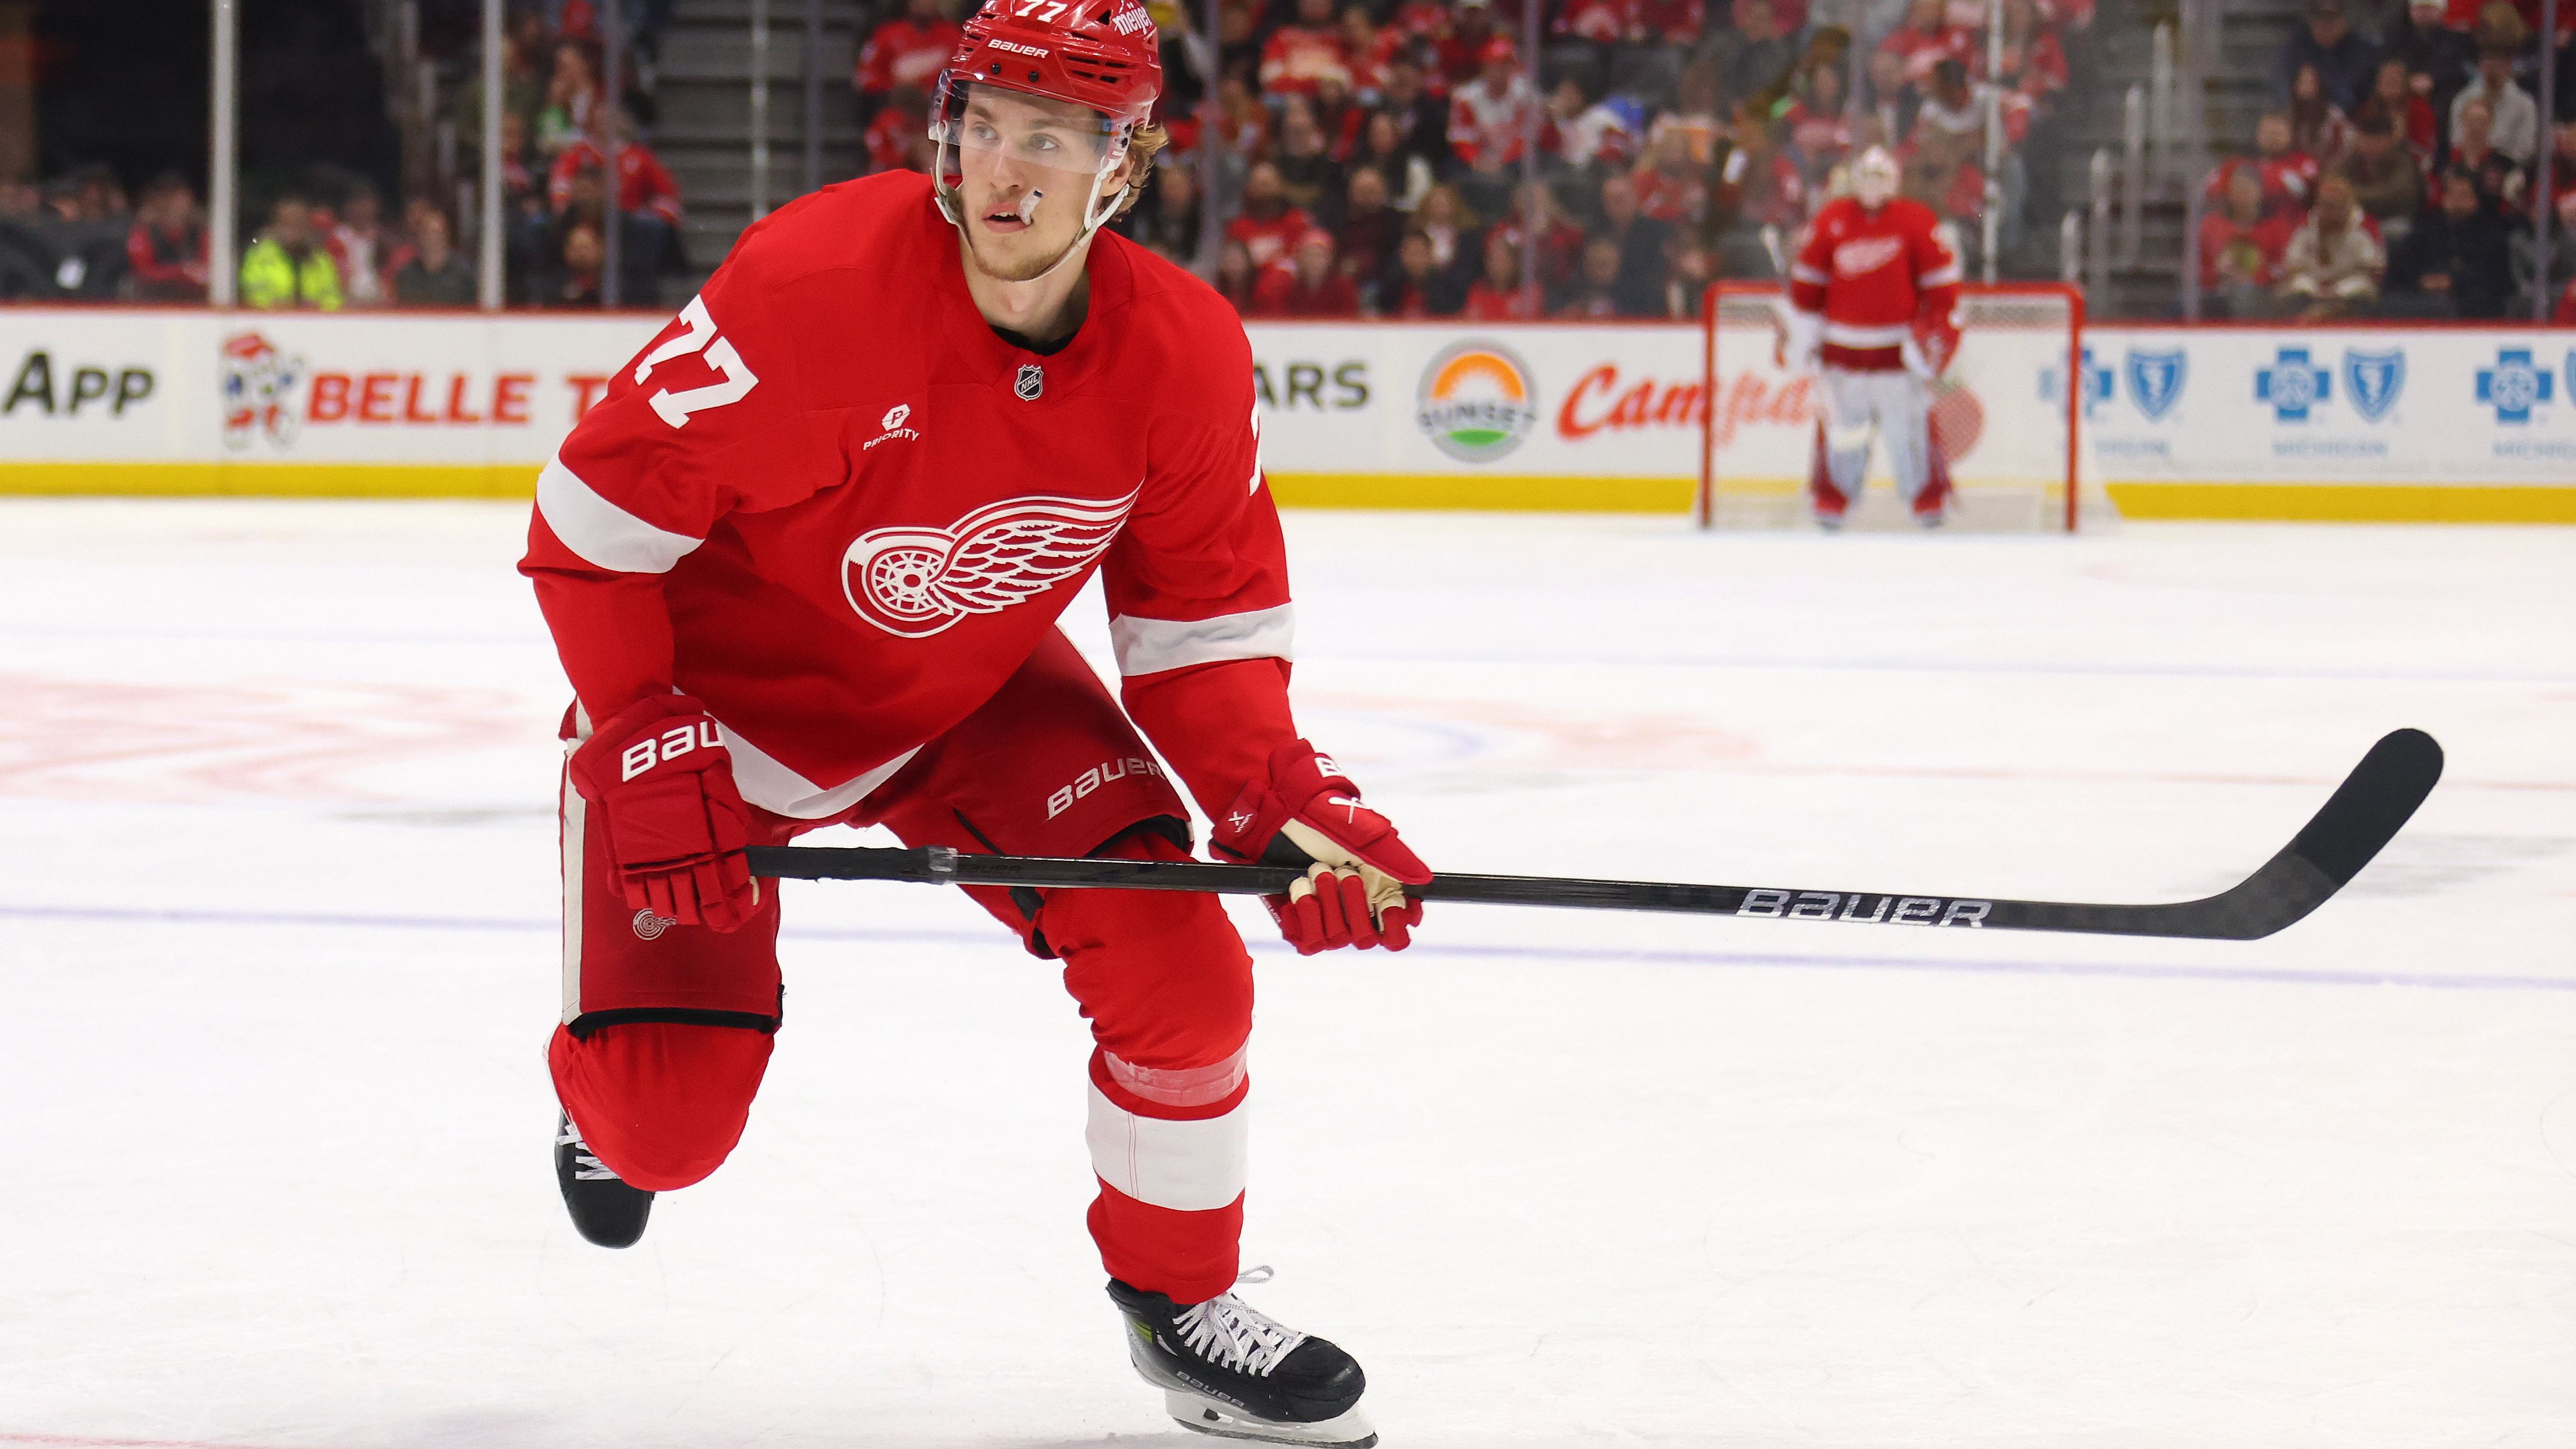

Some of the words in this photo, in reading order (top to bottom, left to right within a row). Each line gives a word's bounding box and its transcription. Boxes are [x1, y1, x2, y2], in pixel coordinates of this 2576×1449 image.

[1015, 0, 1068, 23] 77
[987, 38, 1050, 59] BAUER
[634, 293, 759, 430] 77
[306, 373, 536, 423] BELLE
[1021, 375, 1038, 392] NHL
[863, 428, 920, 451] PRIORITY
[622, 721, 725, 782] BAU
[1046, 757, 1168, 820] BAUER
[1735, 889, 1993, 929] BAUER
[1176, 1370, 1245, 1408] BAUER
